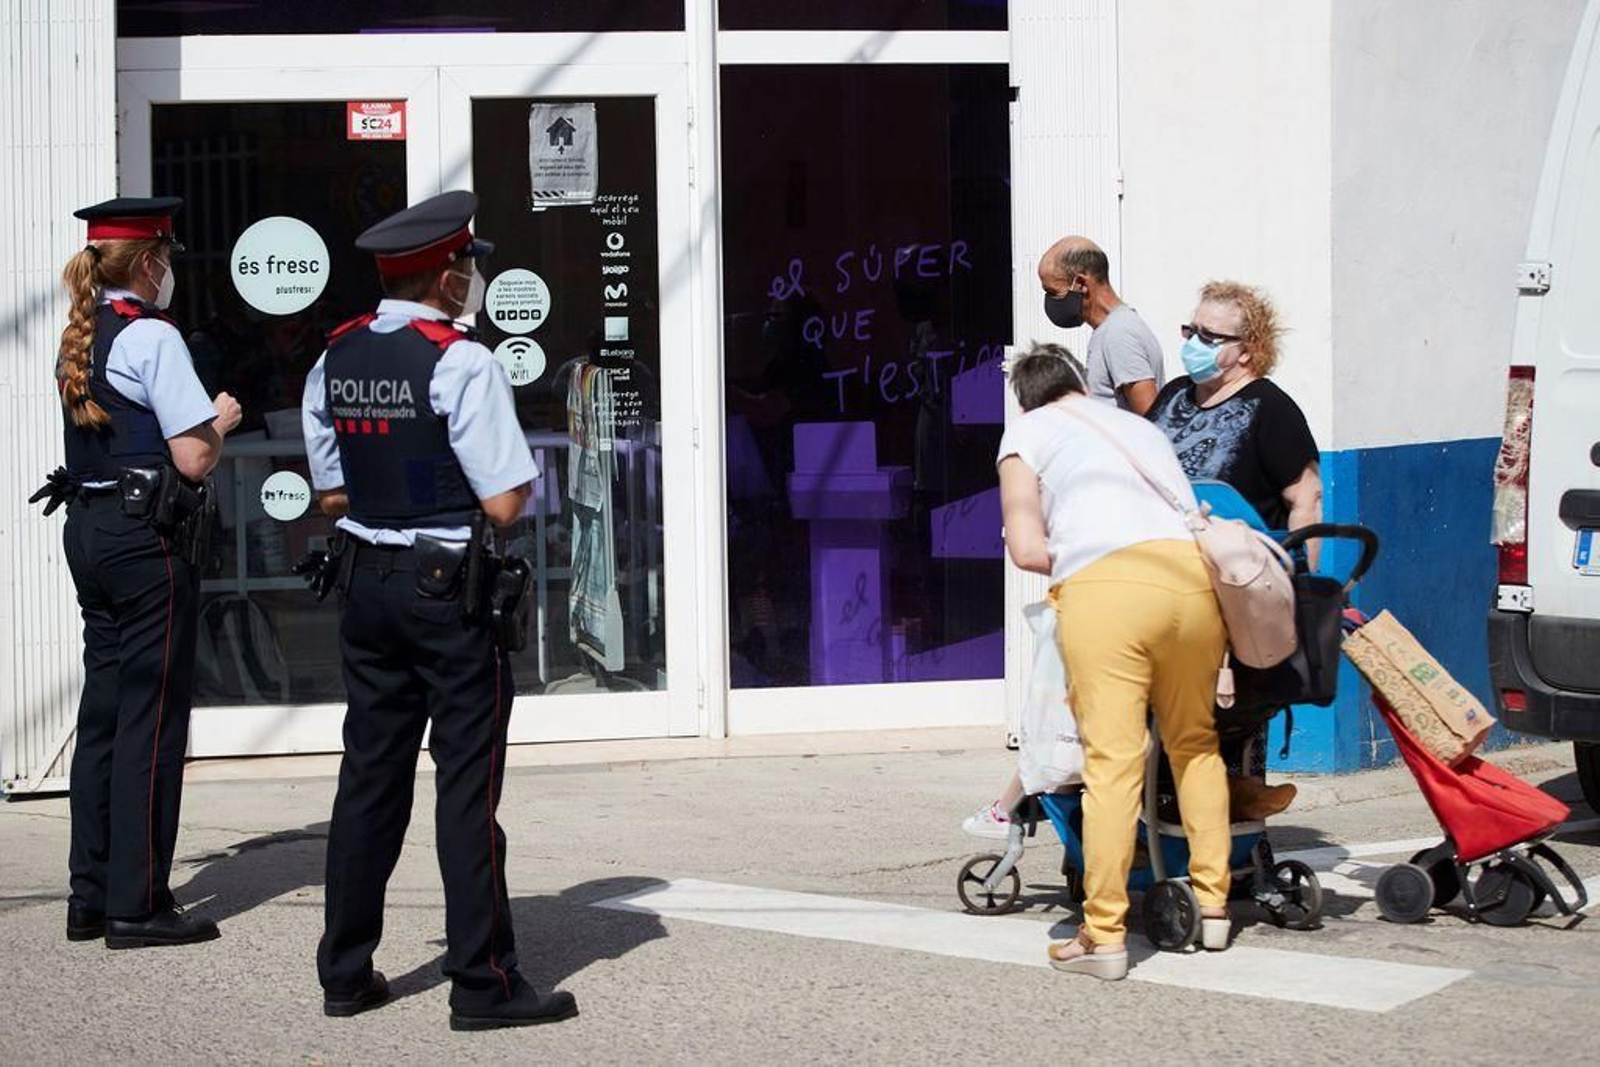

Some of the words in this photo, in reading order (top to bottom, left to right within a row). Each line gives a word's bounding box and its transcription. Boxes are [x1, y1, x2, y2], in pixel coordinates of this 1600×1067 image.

[594, 195, 640, 205] ecarrega
[611, 203, 620, 214] el
[238, 255, 260, 275] és
[266, 254, 320, 274] fresc
[602, 264, 630, 275] yoigo
[768, 258, 805, 300] el
[802, 308, 876, 349] QUE
[330, 378, 414, 404] POLICIA
[363, 405, 417, 421] d'esquadra
